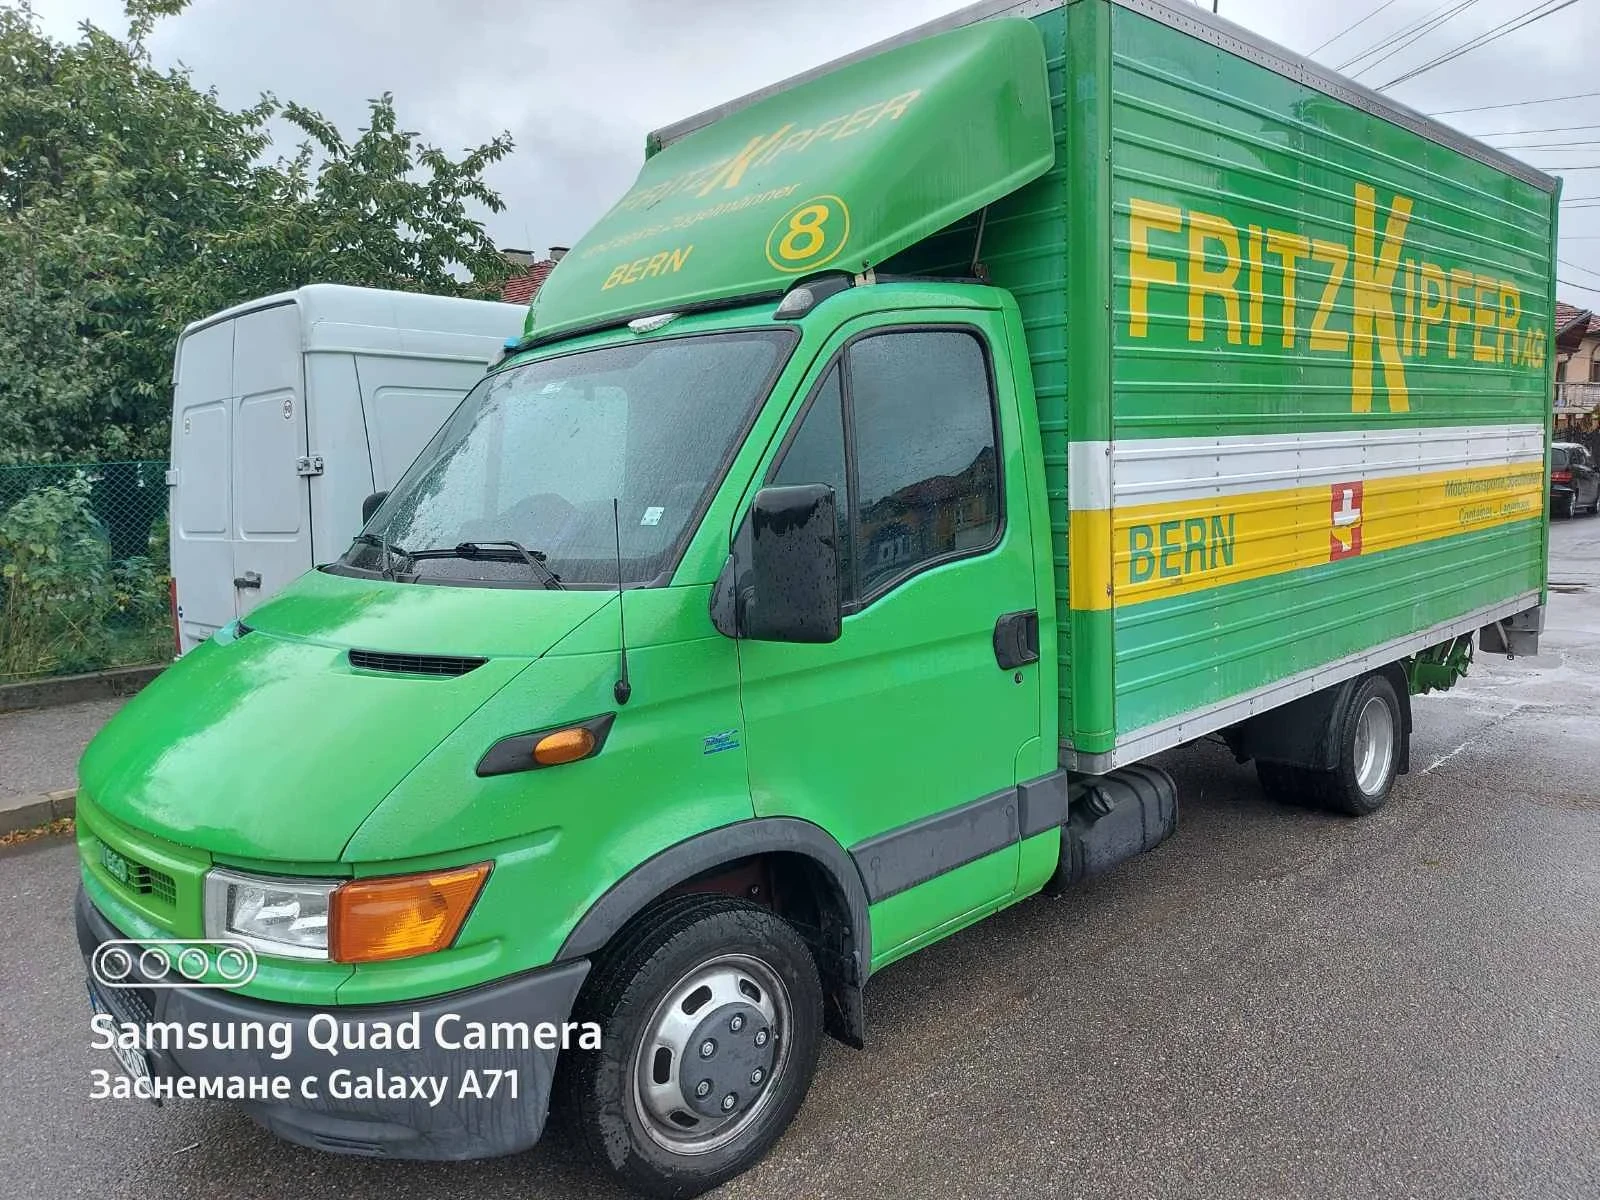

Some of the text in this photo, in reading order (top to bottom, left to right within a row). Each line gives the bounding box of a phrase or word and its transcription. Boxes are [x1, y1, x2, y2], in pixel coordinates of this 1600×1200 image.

[779, 205, 829, 260] 8
[602, 245, 693, 290] BERN
[1128, 182, 1545, 413] FRITZ KIPFER AG
[1128, 513, 1236, 585] BERN
